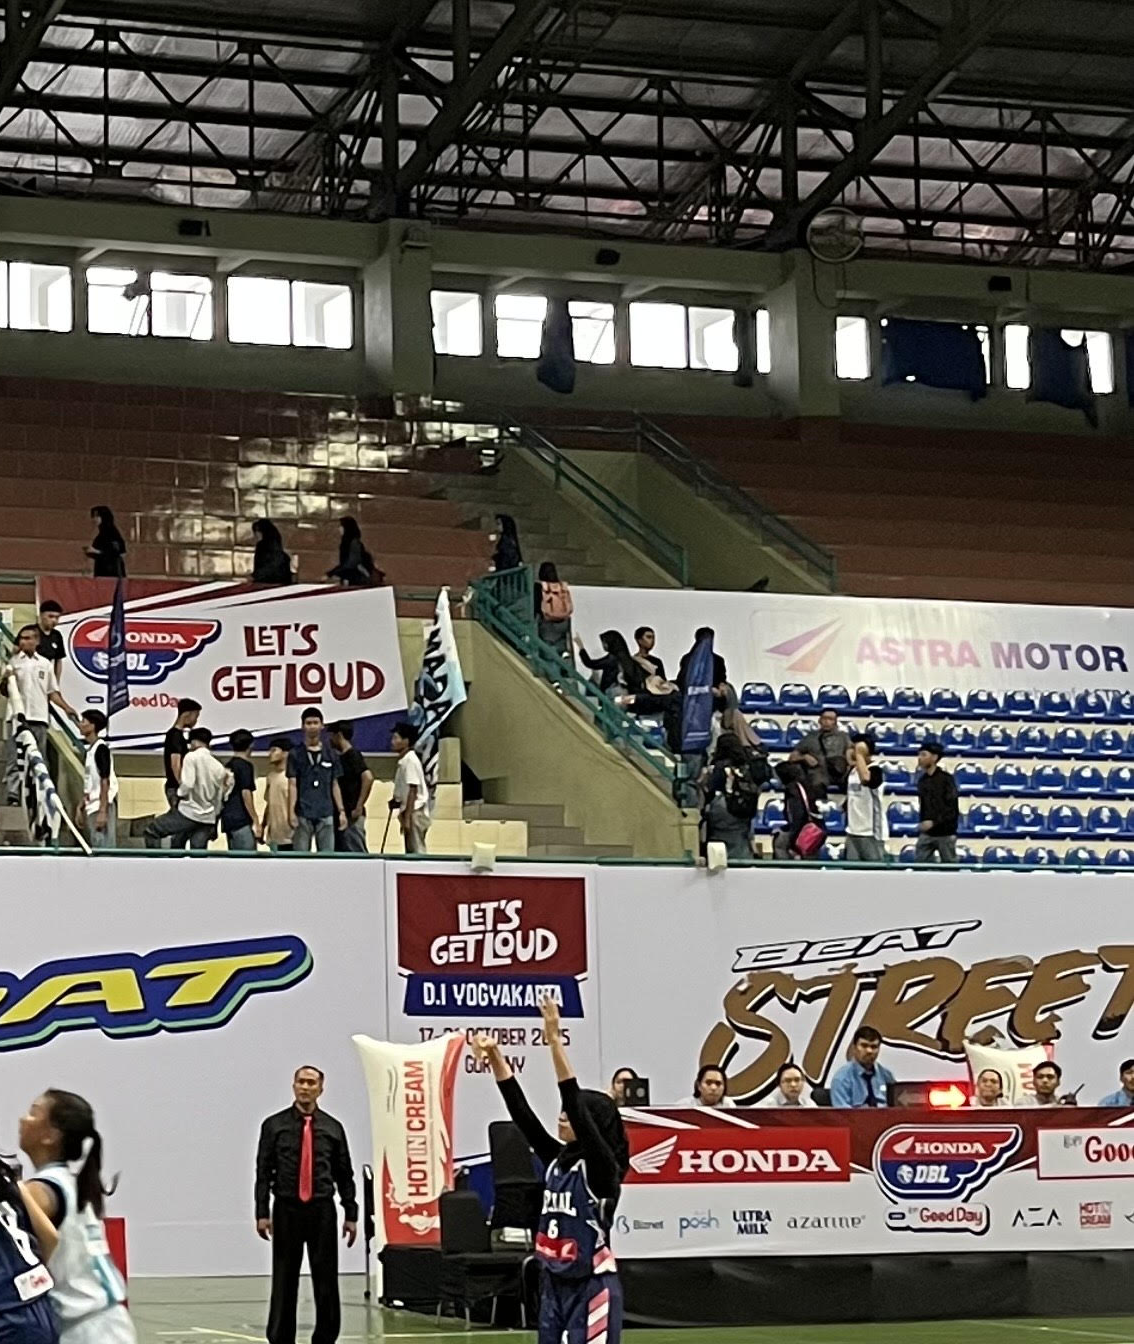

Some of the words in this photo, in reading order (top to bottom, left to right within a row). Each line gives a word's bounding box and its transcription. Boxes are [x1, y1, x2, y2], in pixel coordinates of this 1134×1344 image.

[125, 631, 187, 645] ONDA
[243, 622, 319, 657] LET'S
[855, 634, 981, 668] ASTRA
[989, 641, 1129, 673] MOTOR
[211, 664, 282, 702] GET
[283, 660, 386, 706] LOUD
[458, 899, 523, 933] LET'S
[430, 934, 483, 966] GET
[482, 927, 559, 967] LOUD
[423, 982, 446, 1006] D.I
[452, 983, 564, 1008] YOGYAKARTA
[698, 944, 1134, 1108] STREET
[403, 1060, 426, 1131] CREAM
[678, 1148, 842, 1174] HONDA
[914, 1141, 987, 1155] HONDA
[407, 1157, 428, 1197] HOT
[913, 1164, 951, 1184] DBL
[956, 1207, 983, 1227] Day
